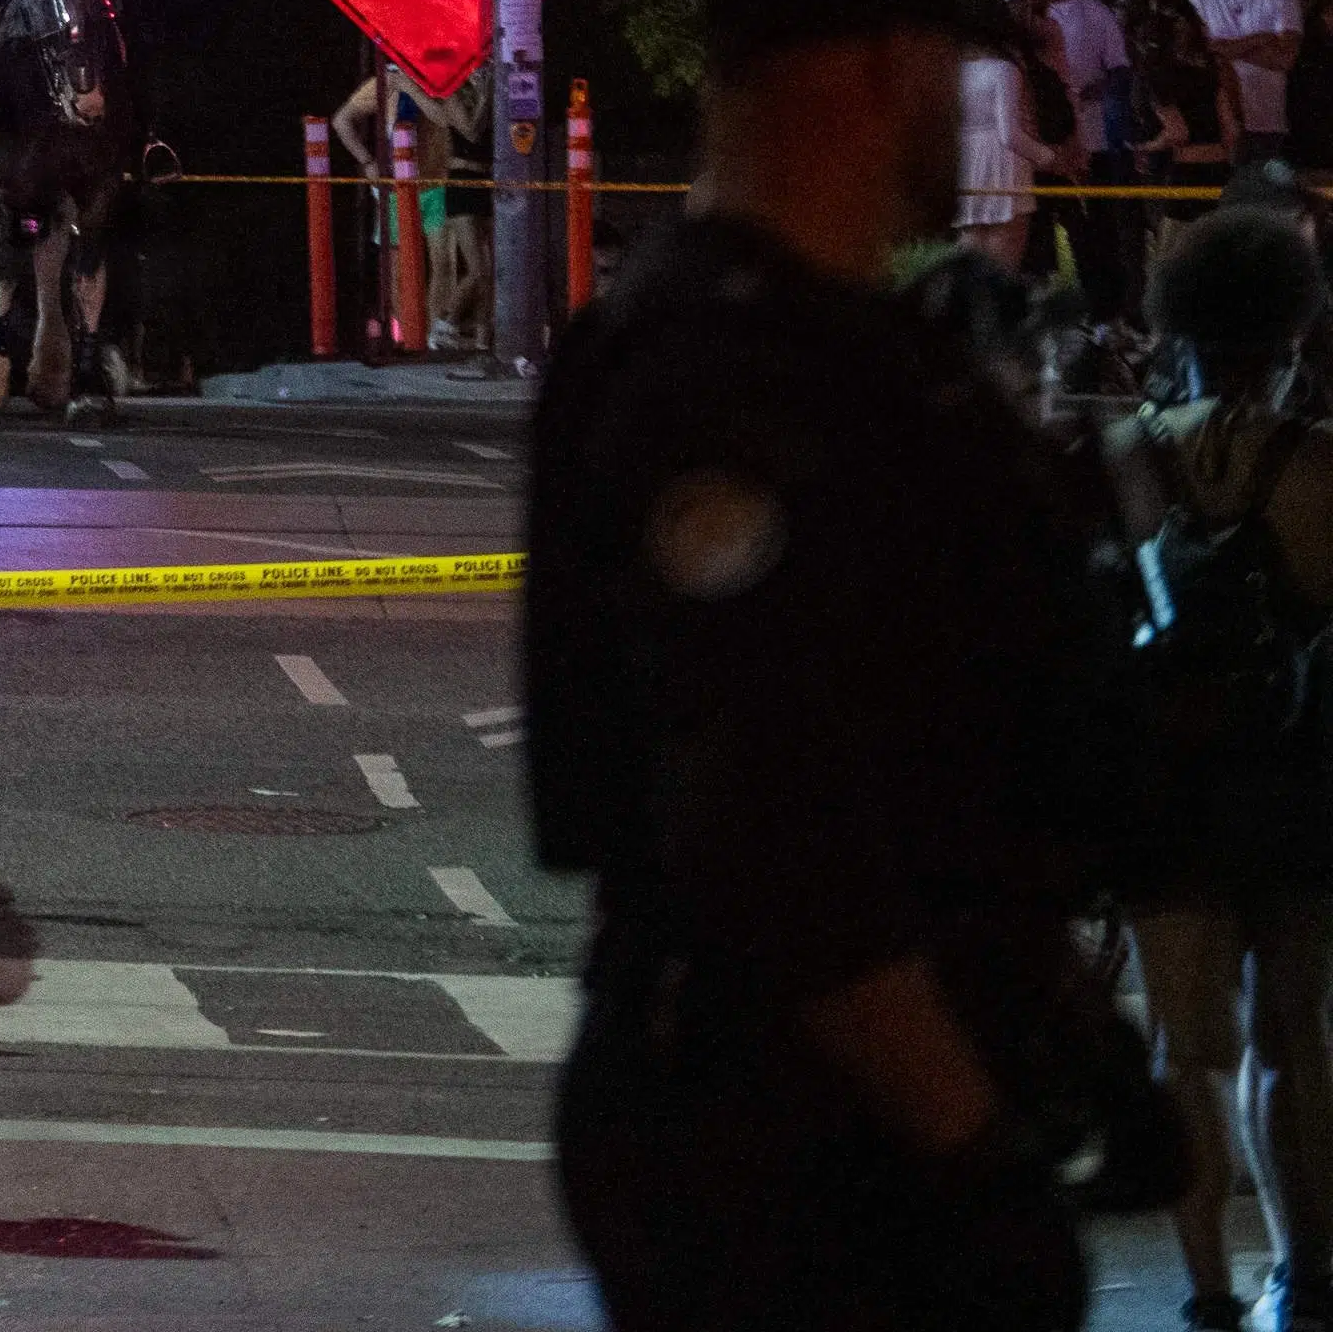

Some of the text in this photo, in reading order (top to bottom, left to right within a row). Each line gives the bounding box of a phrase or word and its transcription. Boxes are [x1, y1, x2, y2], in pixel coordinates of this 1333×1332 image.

[262, 568, 310, 580] POLICE
[355, 566, 370, 577] DO
[376, 565, 396, 576] NOT
[401, 564, 439, 575] CROSS
[454, 560, 501, 572] POLICE
[17, 576, 54, 587] CROSS
[70, 574, 117, 585] POLICE
[163, 572, 178, 583] DO
[183, 572, 204, 582] NOT
[209, 570, 246, 582] CROSS
